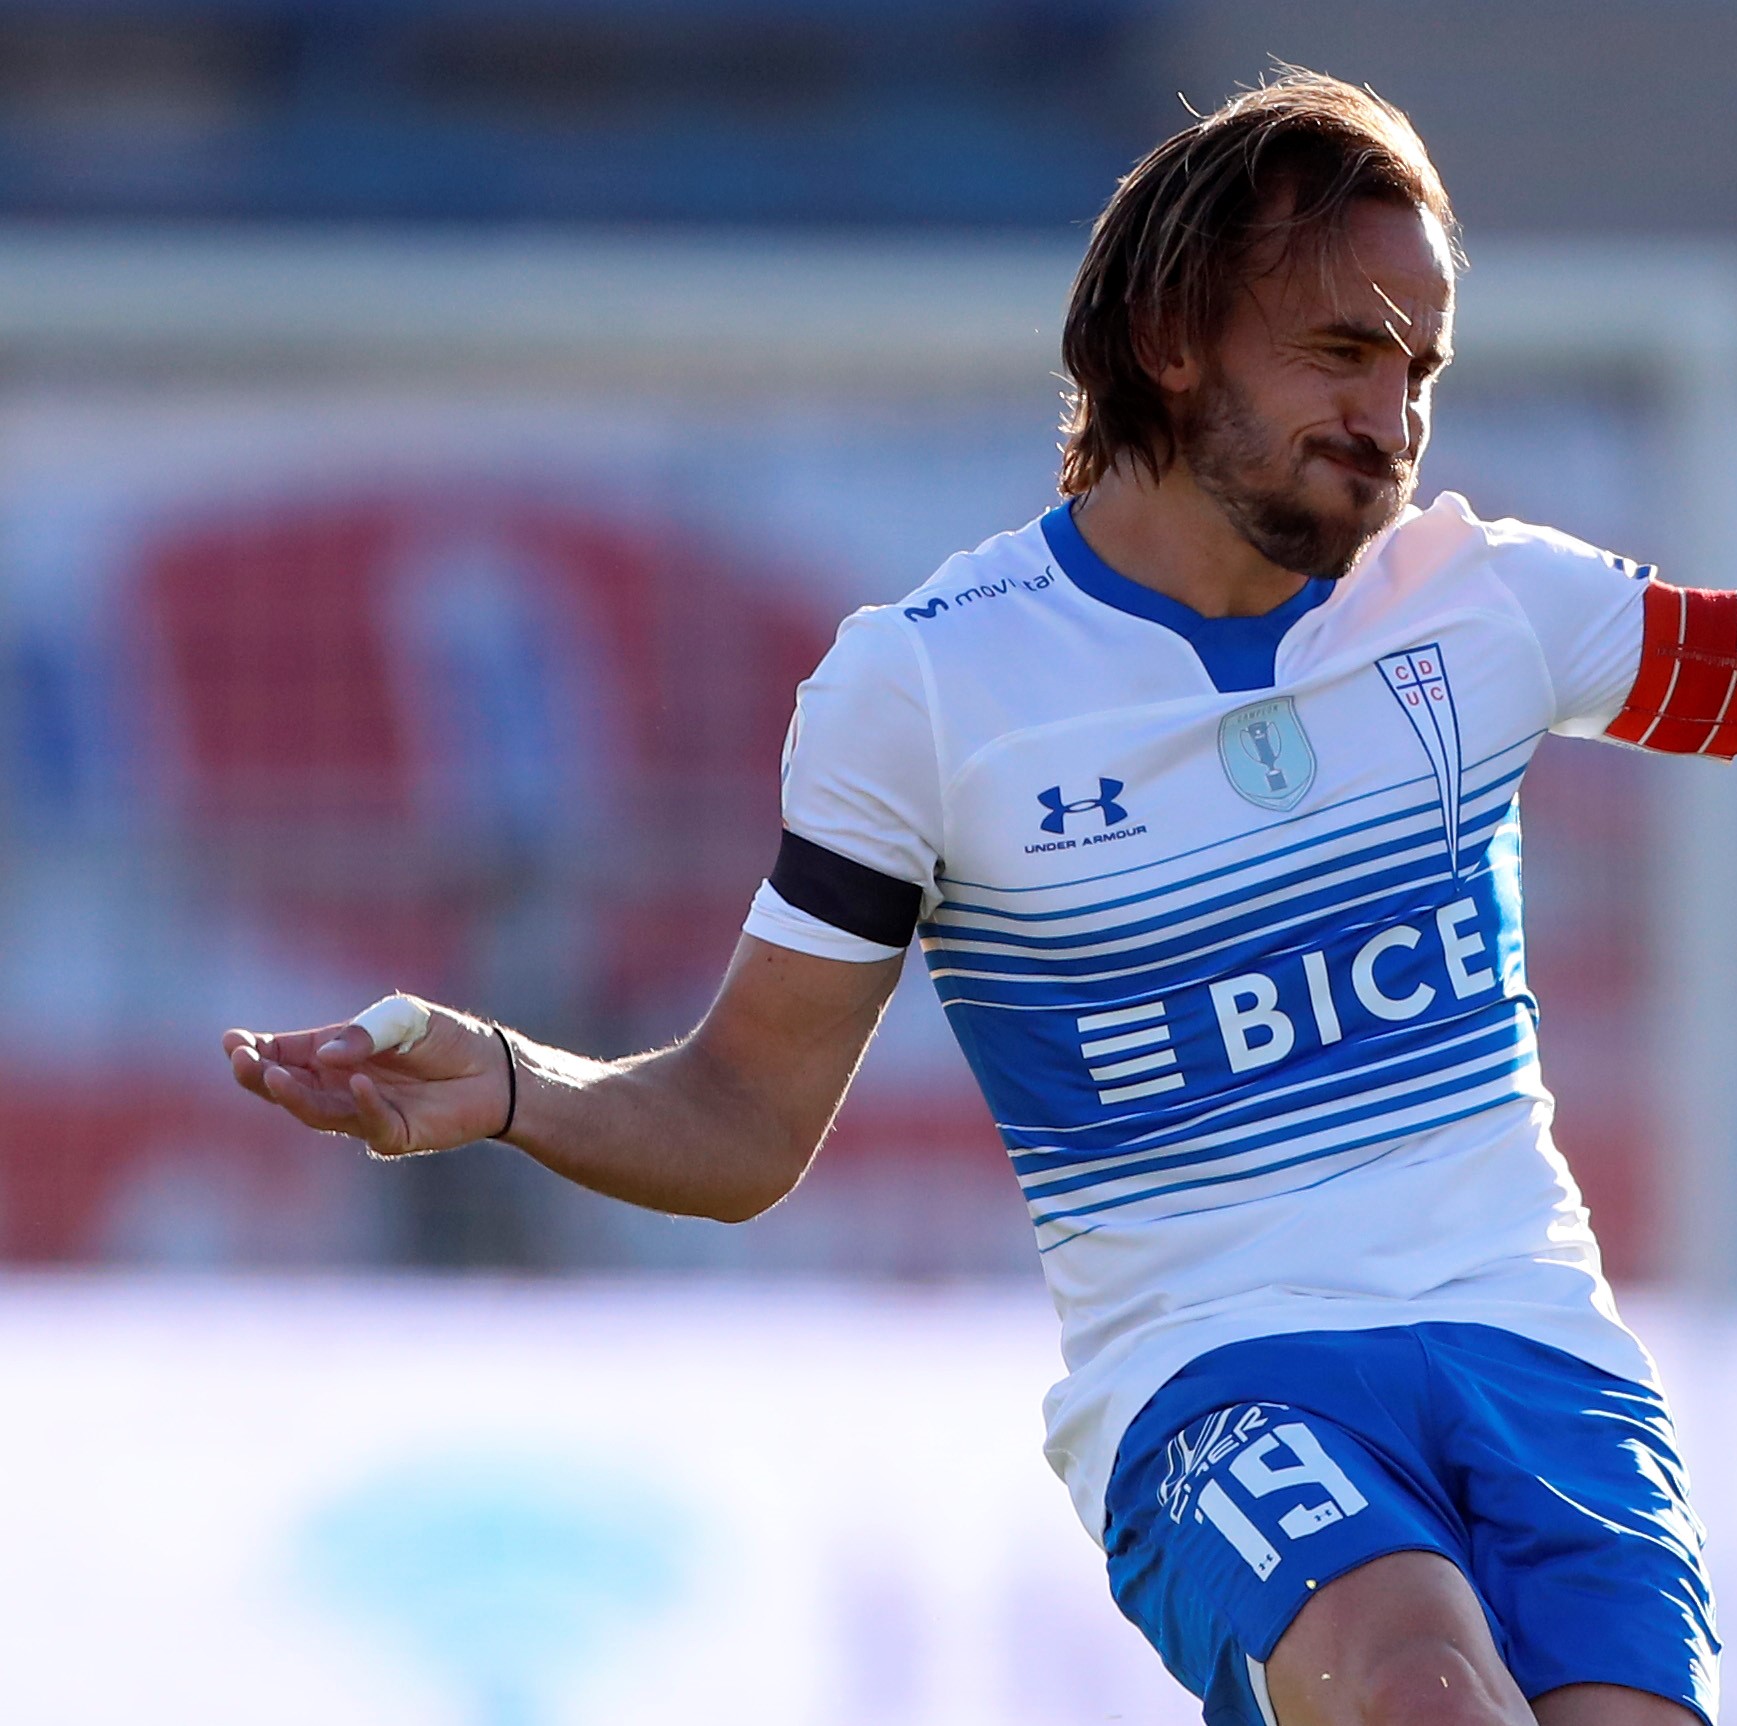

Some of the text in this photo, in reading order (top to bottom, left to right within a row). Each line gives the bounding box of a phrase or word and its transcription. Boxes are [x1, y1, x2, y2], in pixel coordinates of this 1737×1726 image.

[955, 565, 1055, 606] movitar
[1024, 825, 1147, 854] UNDER ARMOUR
[1208, 896, 1496, 1075] BICE
[1197, 1422, 1370, 1583] 19
